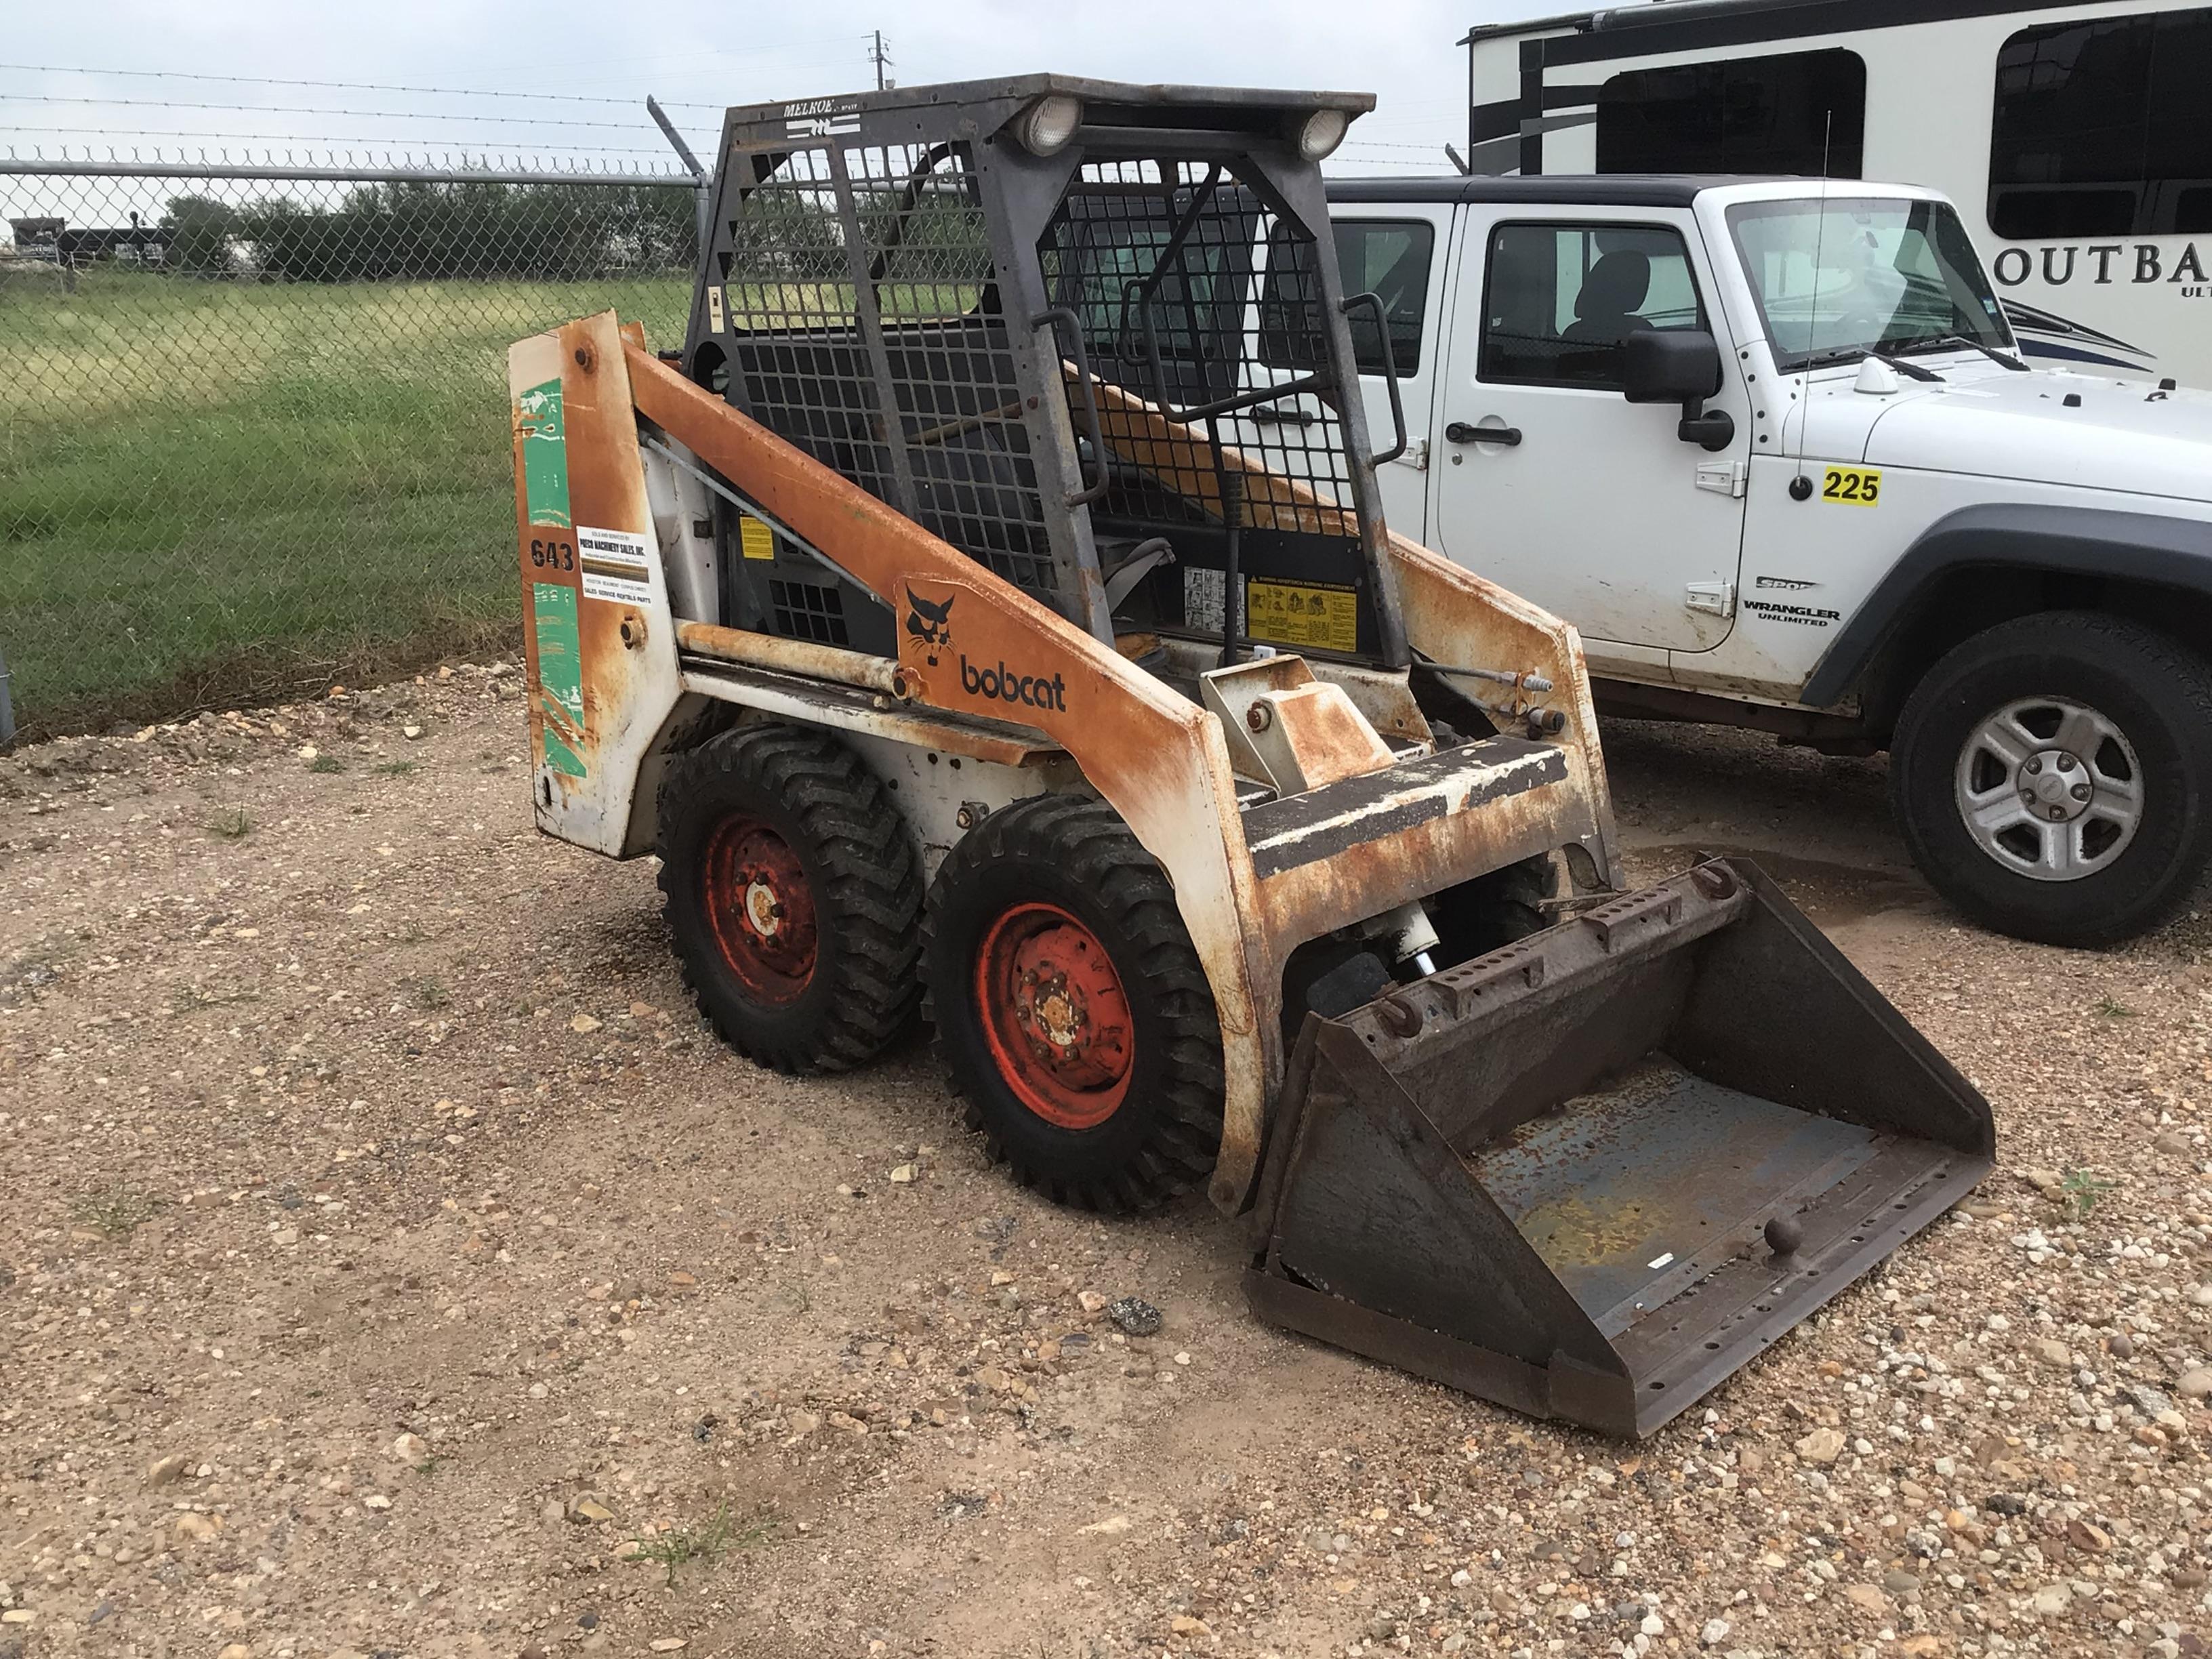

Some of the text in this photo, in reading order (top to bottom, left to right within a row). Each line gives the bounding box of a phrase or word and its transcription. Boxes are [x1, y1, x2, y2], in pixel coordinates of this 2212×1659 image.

[1994, 242, 2210, 286] OUTBA
[1823, 472, 1879, 501] 225
[531, 539, 574, 571] 643
[594, 539, 619, 553] MACHINERY
[598, 589, 615, 598] SERVICE
[637, 596, 651, 604] PARTS
[1743, 600, 1841, 621] WRANGLER
[1758, 613, 1828, 626] UNLIMITED
[960, 654, 1066, 712] bobcat
